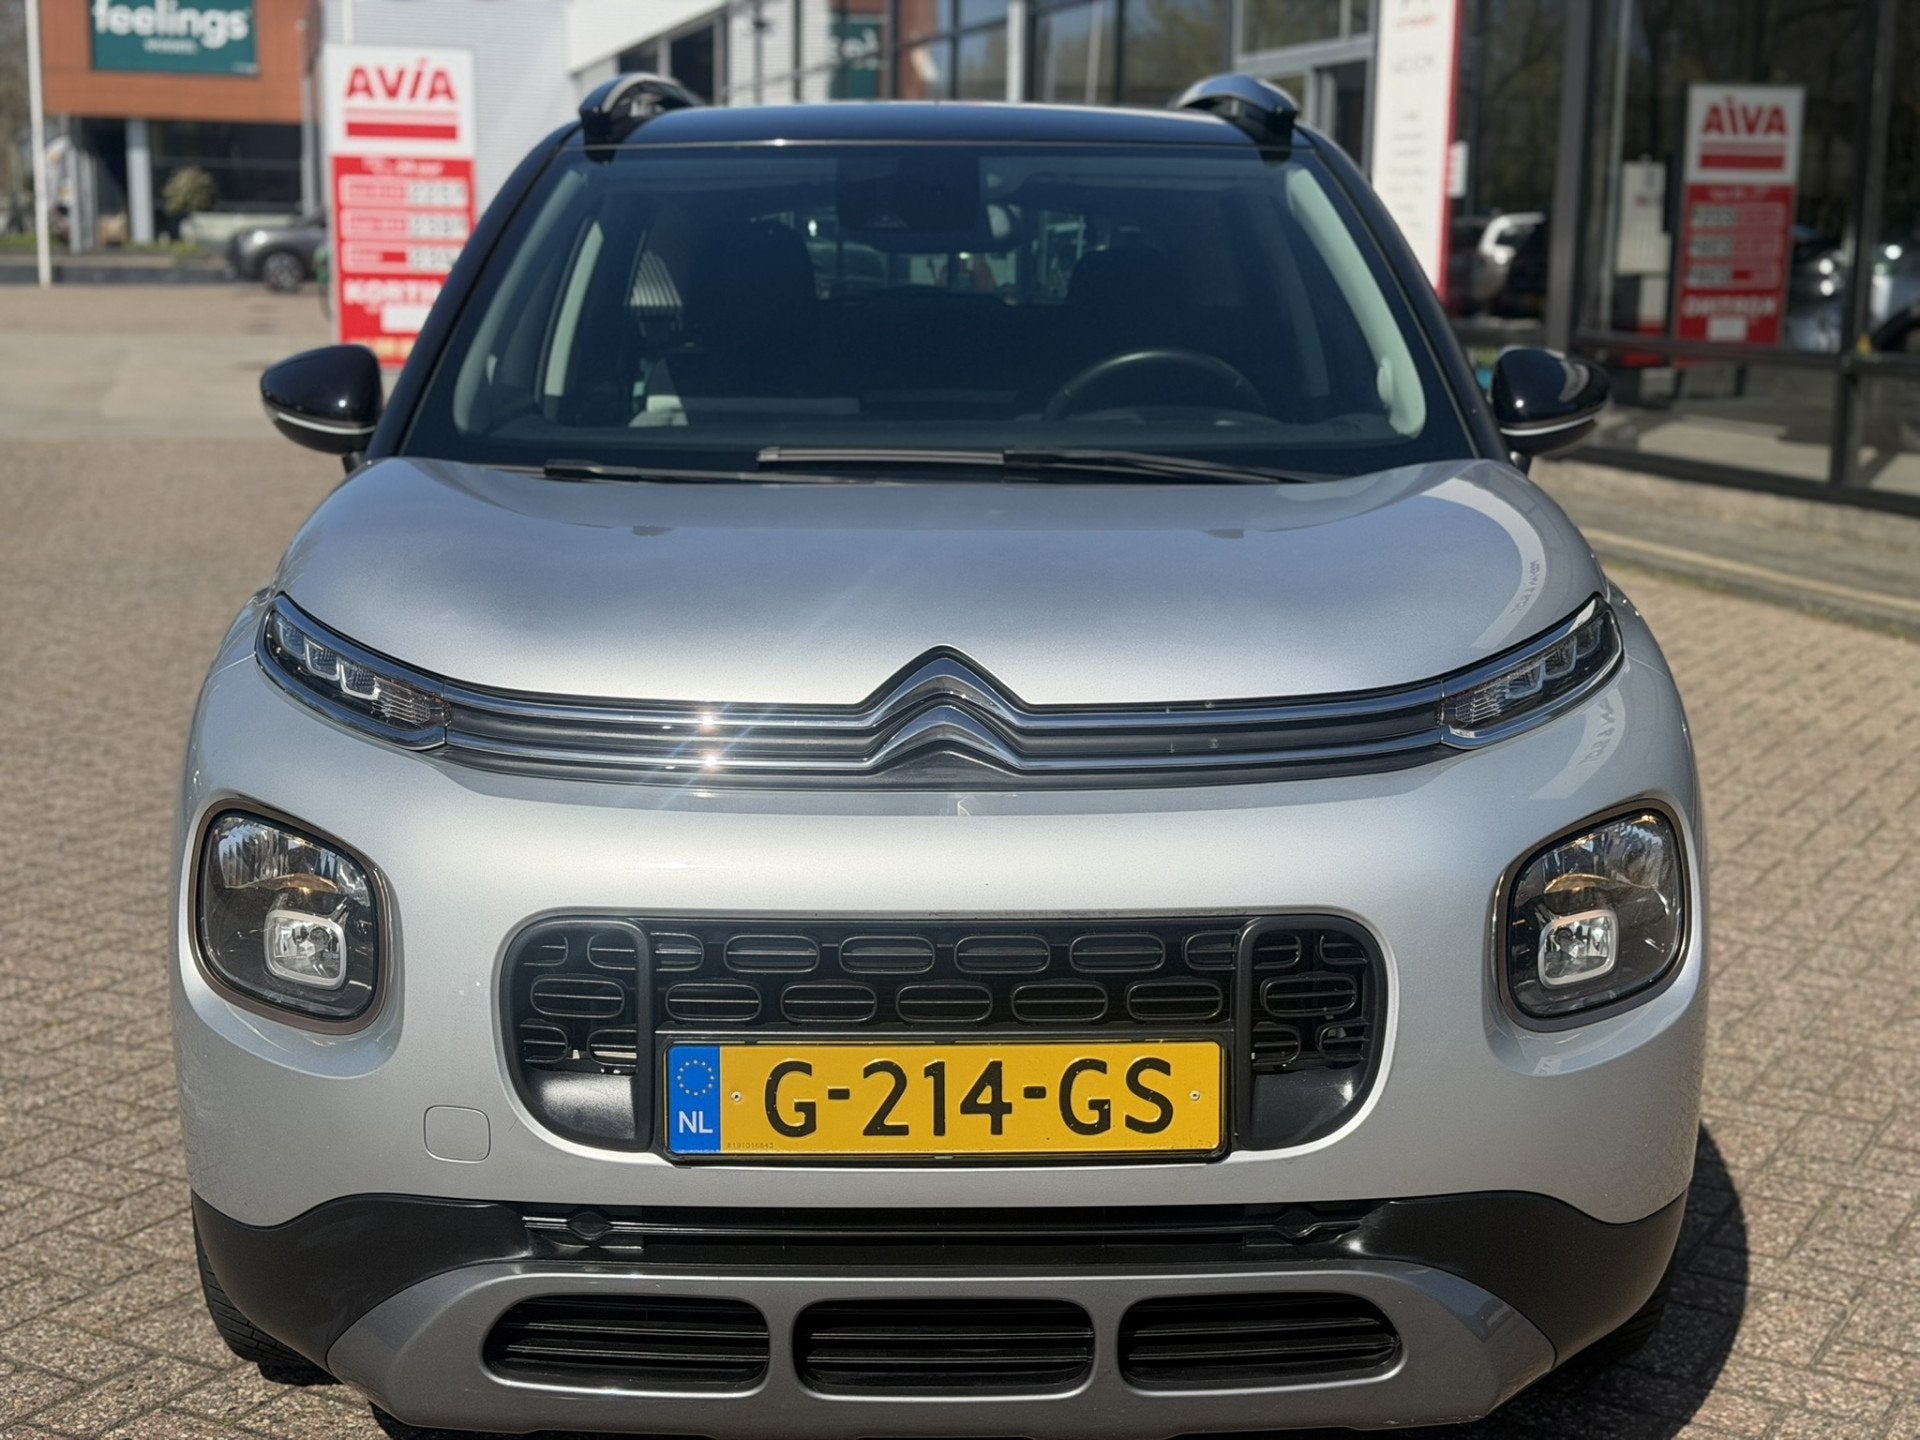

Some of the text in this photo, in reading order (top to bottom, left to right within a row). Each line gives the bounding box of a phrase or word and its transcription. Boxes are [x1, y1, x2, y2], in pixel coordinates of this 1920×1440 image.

[93, 0, 248, 48] feelings
[764, 1058, 1174, 1137] G-214-GS
[679, 1111, 713, 1134] NL
